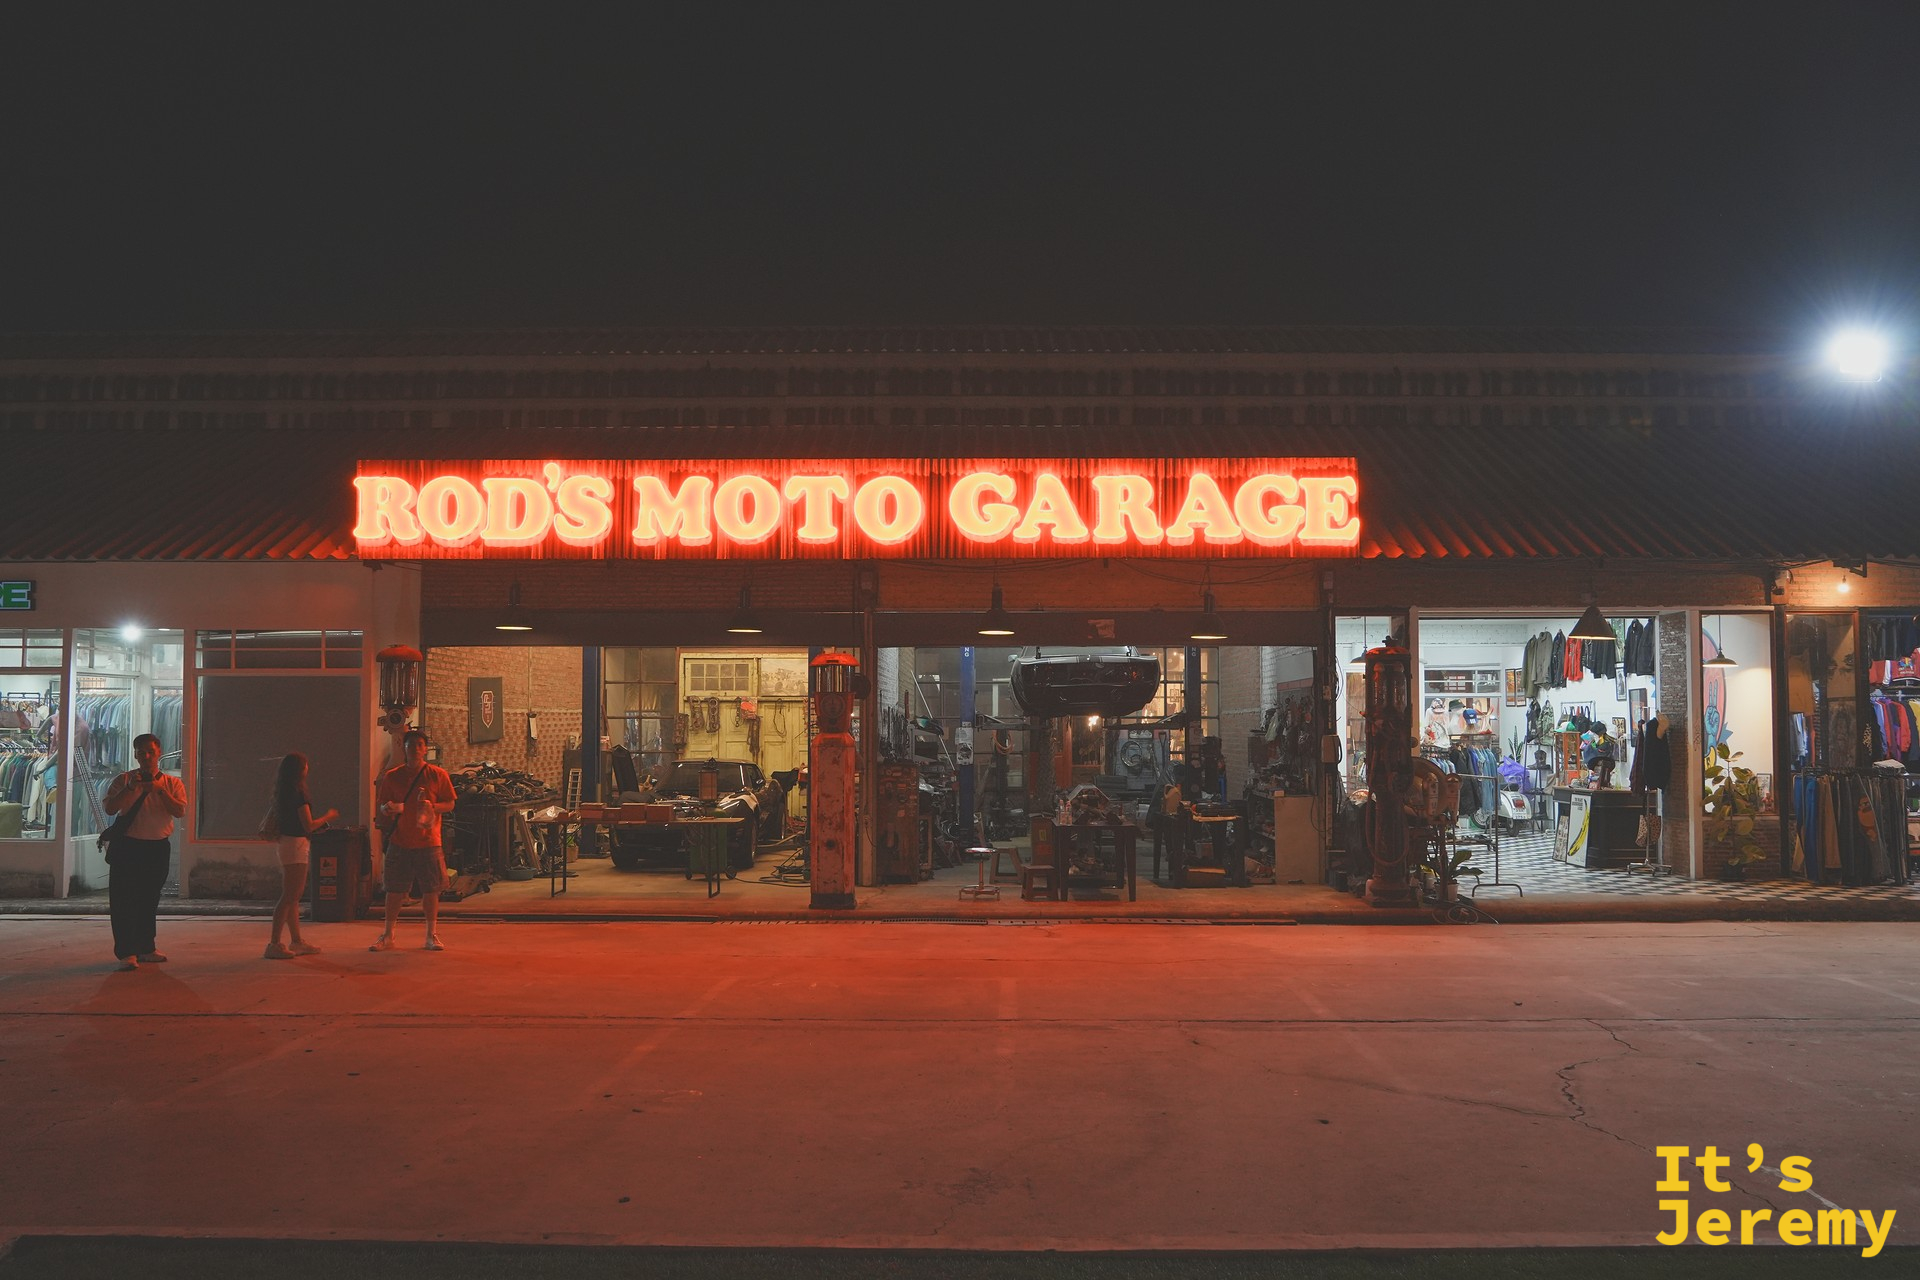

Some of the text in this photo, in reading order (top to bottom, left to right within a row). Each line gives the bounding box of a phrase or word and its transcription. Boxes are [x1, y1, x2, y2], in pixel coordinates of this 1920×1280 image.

[353, 462, 1361, 545] ROD'S MOTO GARAGE
